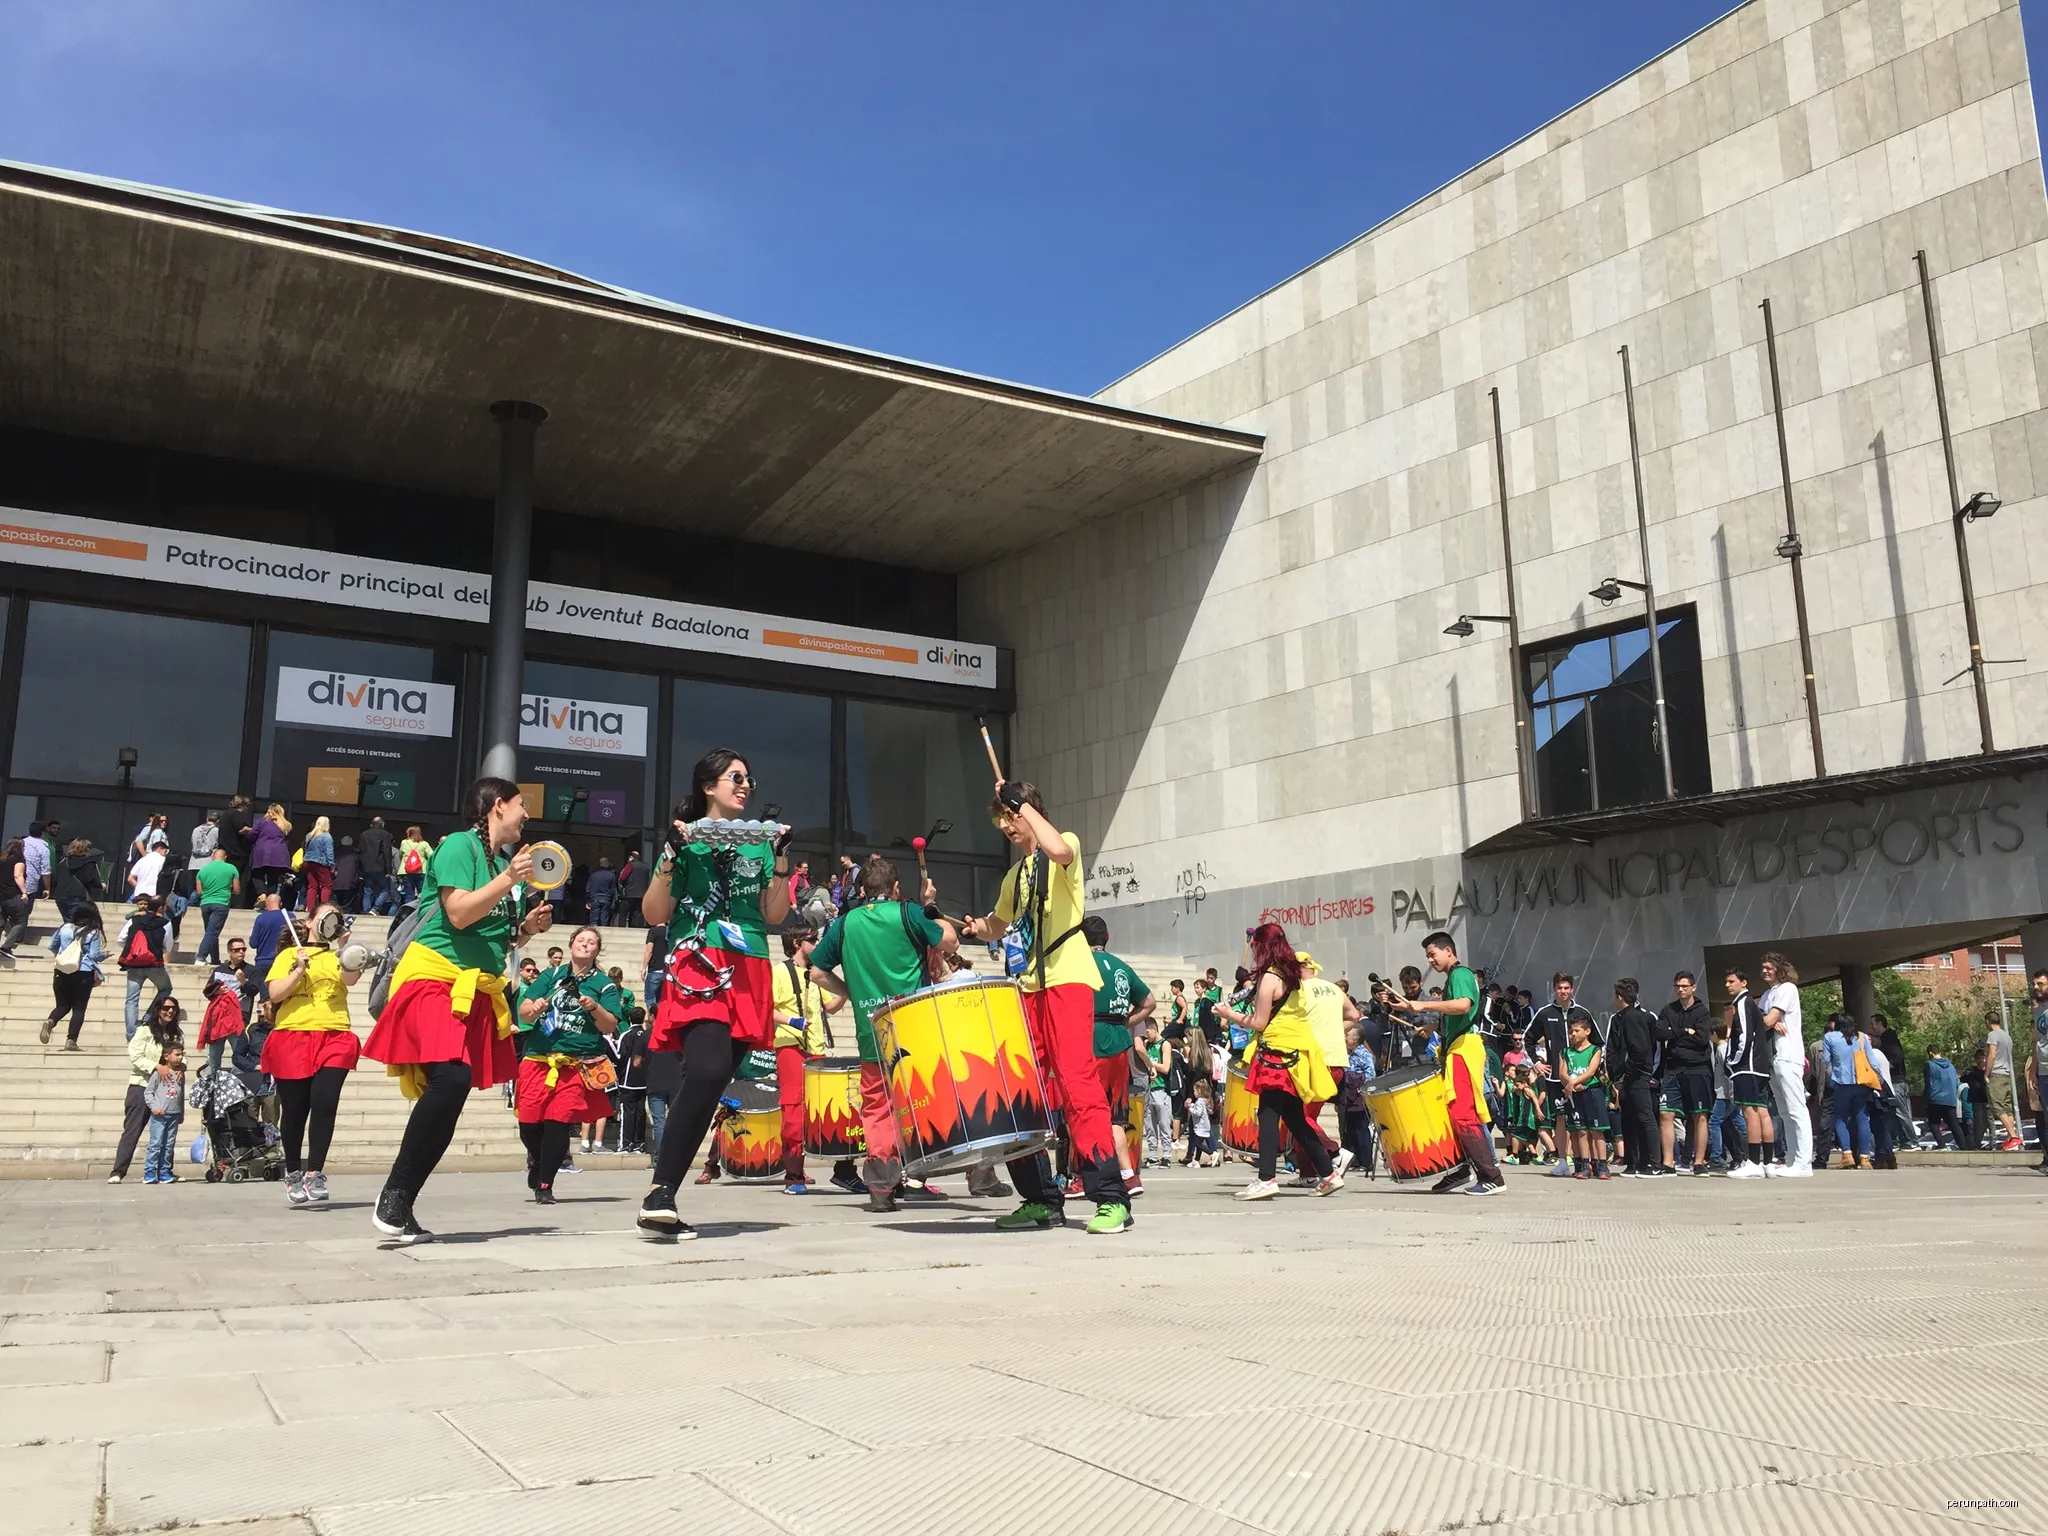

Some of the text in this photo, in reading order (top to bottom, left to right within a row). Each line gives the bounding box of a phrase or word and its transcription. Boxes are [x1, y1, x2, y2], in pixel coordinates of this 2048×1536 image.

[0, 528, 97, 550] apastora.com
[166, 545, 750, 641] Patrocinador principal del ub Joventut Badalona
[799, 637, 885, 656] divinapastora.com
[926, 645, 982, 670] divina
[953, 667, 982, 678] seguros
[308, 673, 428, 715] divina
[365, 714, 426, 730] seguros
[520, 697, 623, 736] divina
[347, 748, 365, 756] SOCIS
[369, 750, 401, 759] ENTRADES
[568, 735, 623, 750] seguros
[572, 769, 602, 777] ENTRADES
[1184, 885, 1207, 915] PP
[1391, 876, 1500, 934] PALAU
[1512, 846, 1737, 912] MUNICIPAL
